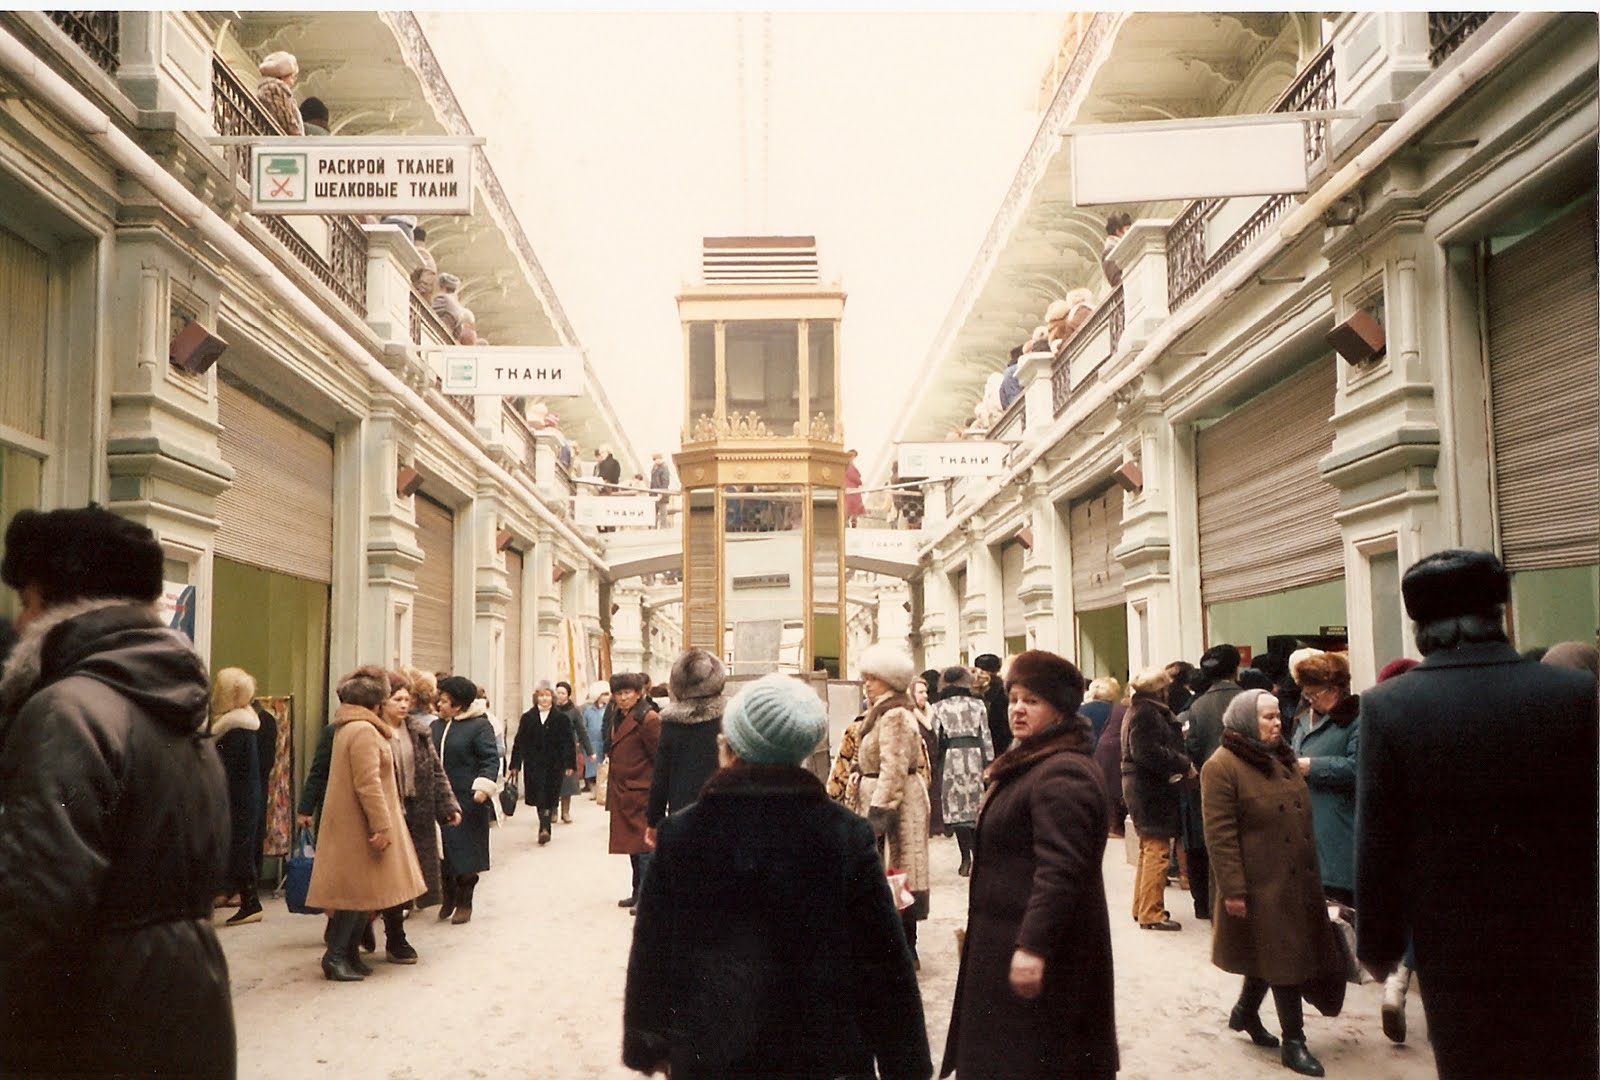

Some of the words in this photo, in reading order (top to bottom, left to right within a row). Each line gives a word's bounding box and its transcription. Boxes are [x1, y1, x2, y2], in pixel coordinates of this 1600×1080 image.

[318, 157, 385, 174] РАСКРОЙ
[397, 157, 454, 174] ТКАНЕЙ
[314, 181, 398, 198] ШЕЛКОВЫЕ
[409, 181, 458, 197] ТКАНИ
[494, 368, 562, 380] ТКАНИ
[939, 456, 989, 465] ТКАНИ
